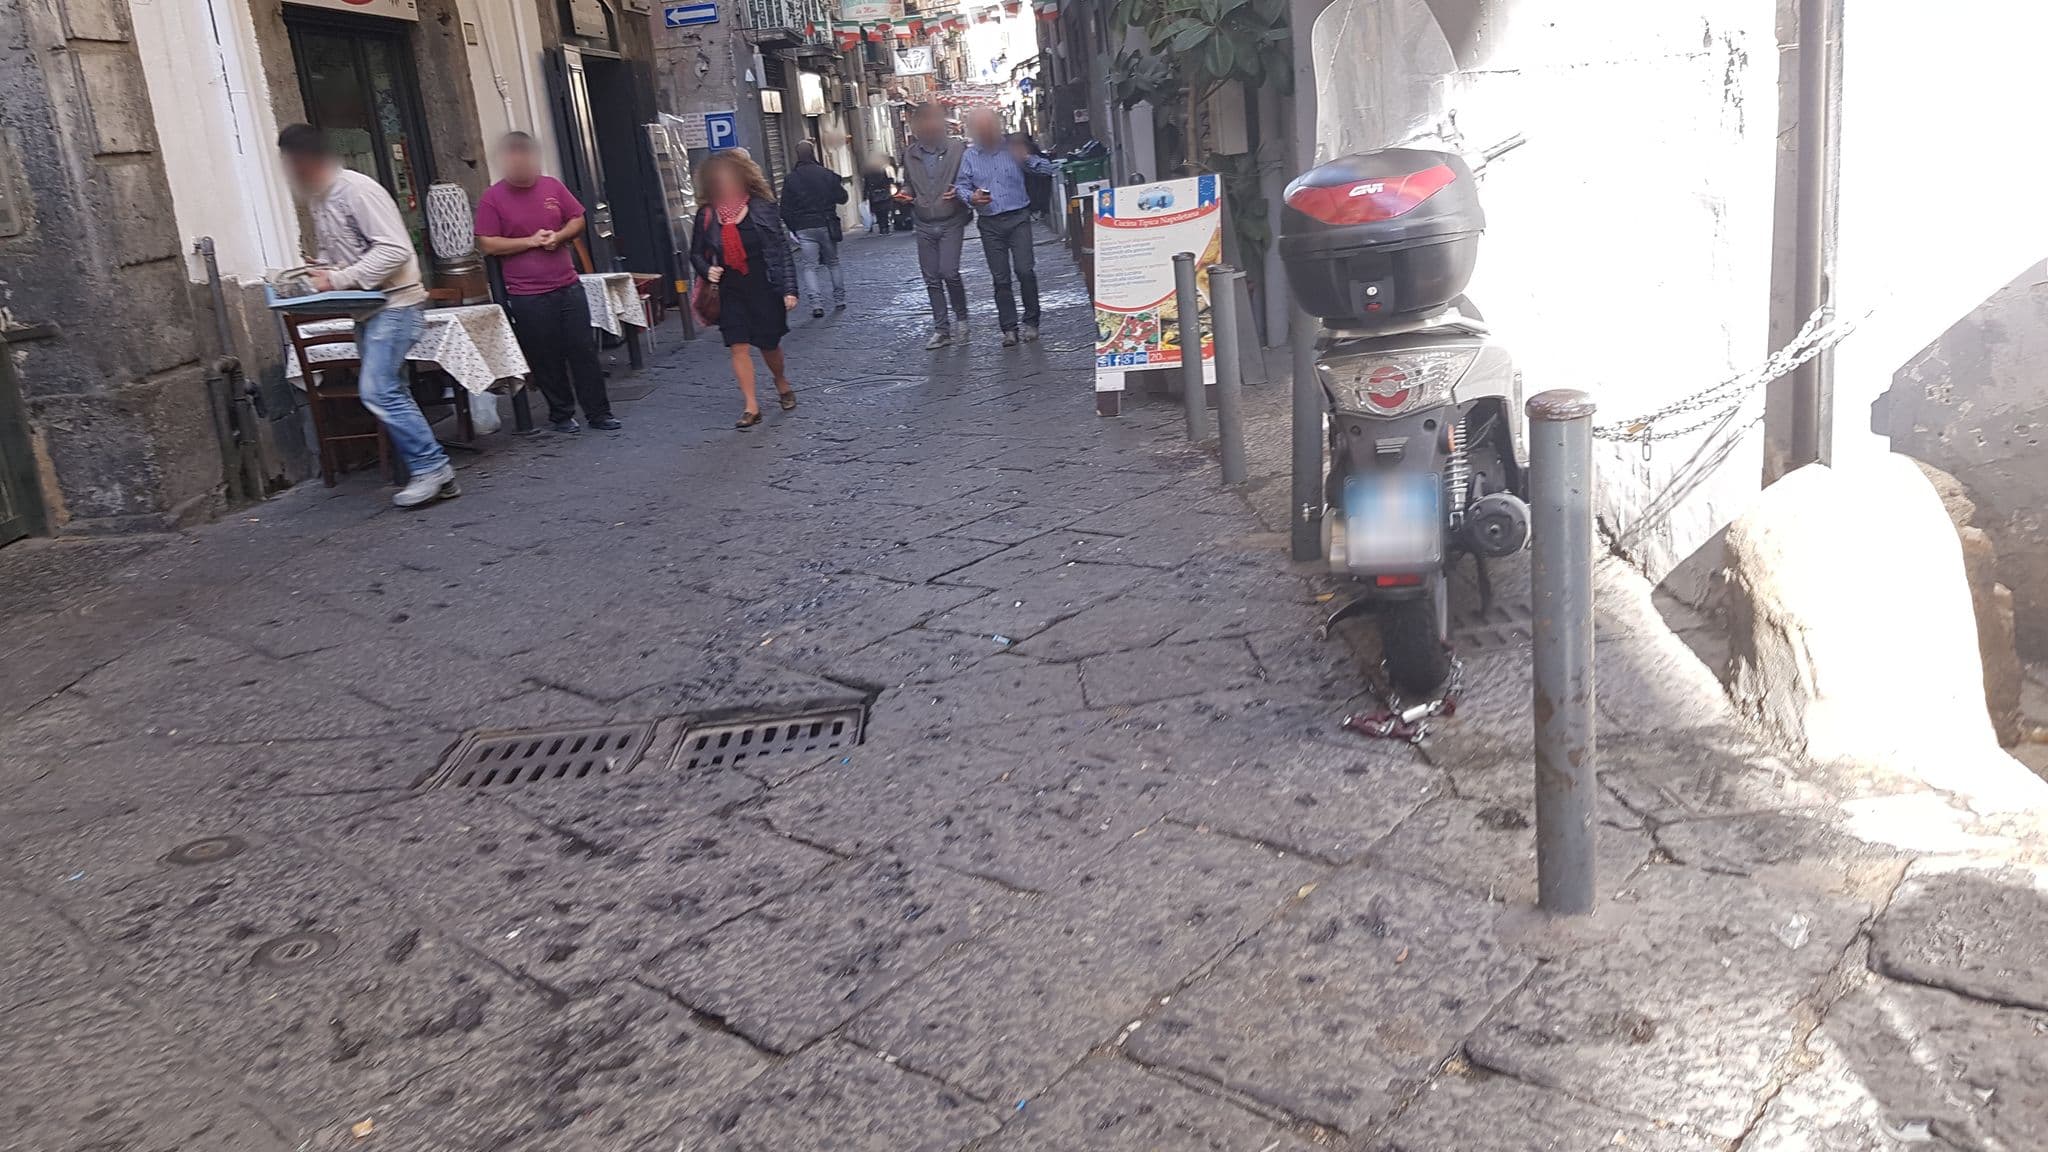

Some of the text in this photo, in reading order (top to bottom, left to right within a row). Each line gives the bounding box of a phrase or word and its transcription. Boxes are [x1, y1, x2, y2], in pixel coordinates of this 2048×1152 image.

[710, 120, 732, 147] P
[1114, 211, 1199, 228] Cucina Tipica Napoletana
